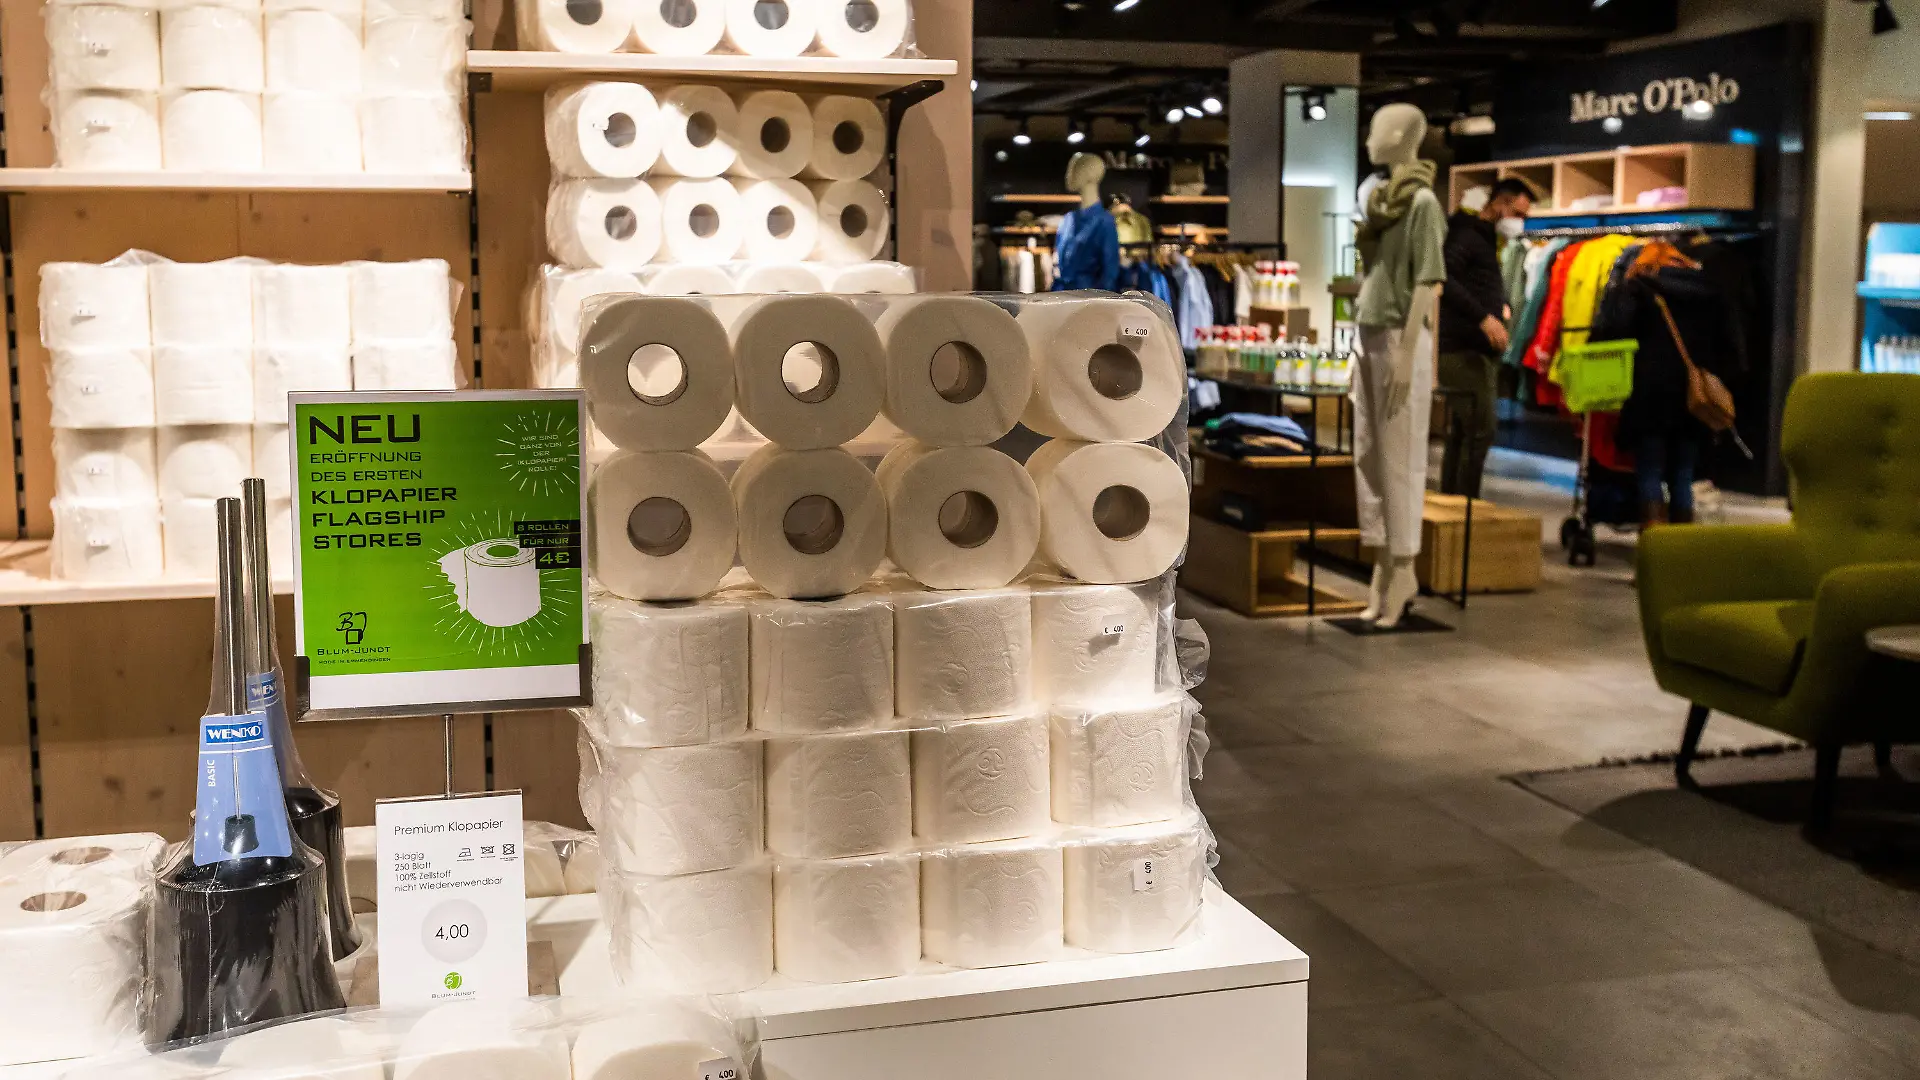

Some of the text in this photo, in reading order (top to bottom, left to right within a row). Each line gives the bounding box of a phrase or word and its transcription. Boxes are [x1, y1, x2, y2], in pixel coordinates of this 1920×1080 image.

[1570, 72, 1740, 123] Marc O'Polo
[1135, 328, 1148, 336] 400
[309, 414, 421, 444] NEU
[310, 450, 422, 464] ERÖFFNUNG
[311, 470, 422, 482] DES ERSTEN
[312, 487, 458, 504] KLOPAPIER
[312, 509, 446, 527] FLAGSHIP
[517, 523, 569, 532] 8 ROLLEN
[314, 532, 422, 550] STORES
[523, 536, 544, 546] FÜR
[540, 552, 570, 564] 4€
[207, 725, 261, 740] WENKO
[206, 760, 216, 787] BASIC
[394, 819, 504, 836] Premium Klopapier
[394, 852, 425, 861] 3-lagig
[394, 862, 432, 872] 250 Blatt
[395, 870, 452, 882] 100% Zellstoff
[394, 878, 503, 892] nicht Wiederverwendbar
[434, 924, 469, 940] 4,00
[718, 1069, 734, 1079] 400
